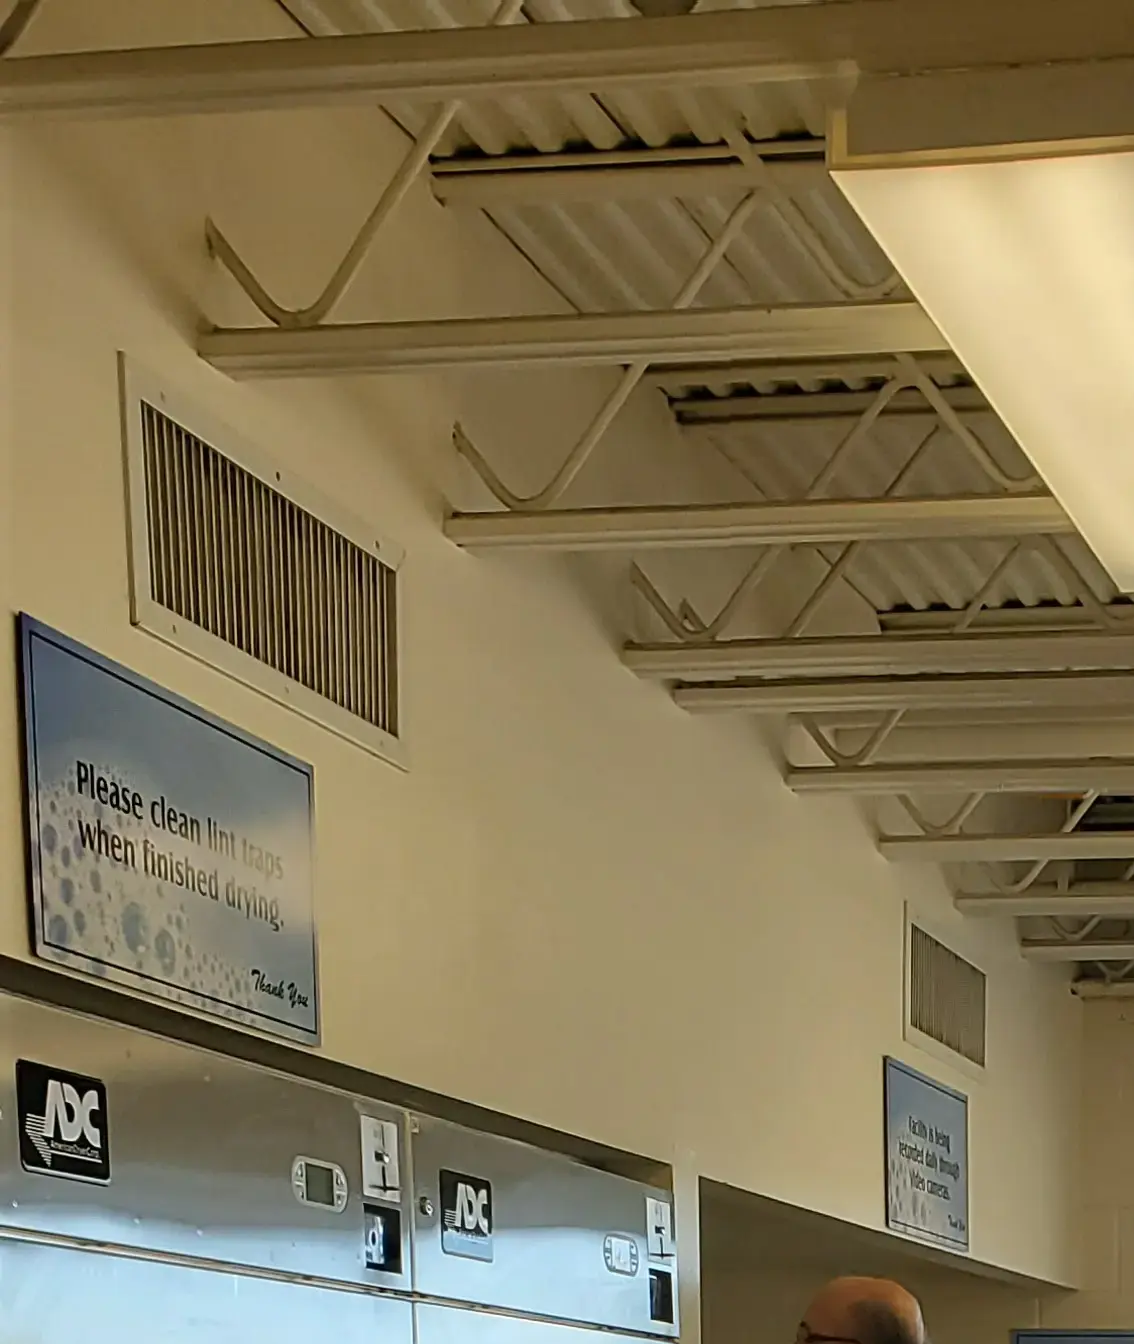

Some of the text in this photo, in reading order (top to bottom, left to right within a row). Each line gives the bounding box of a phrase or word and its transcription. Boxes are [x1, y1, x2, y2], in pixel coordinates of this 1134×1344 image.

[76, 760, 284, 881] Please clean lint traps
[78, 818, 284, 932] when finished drying.
[251, 969, 309, 1008] Thank You
[44, 1079, 101, 1148] ADC
[454, 1182, 488, 1234] ADC
